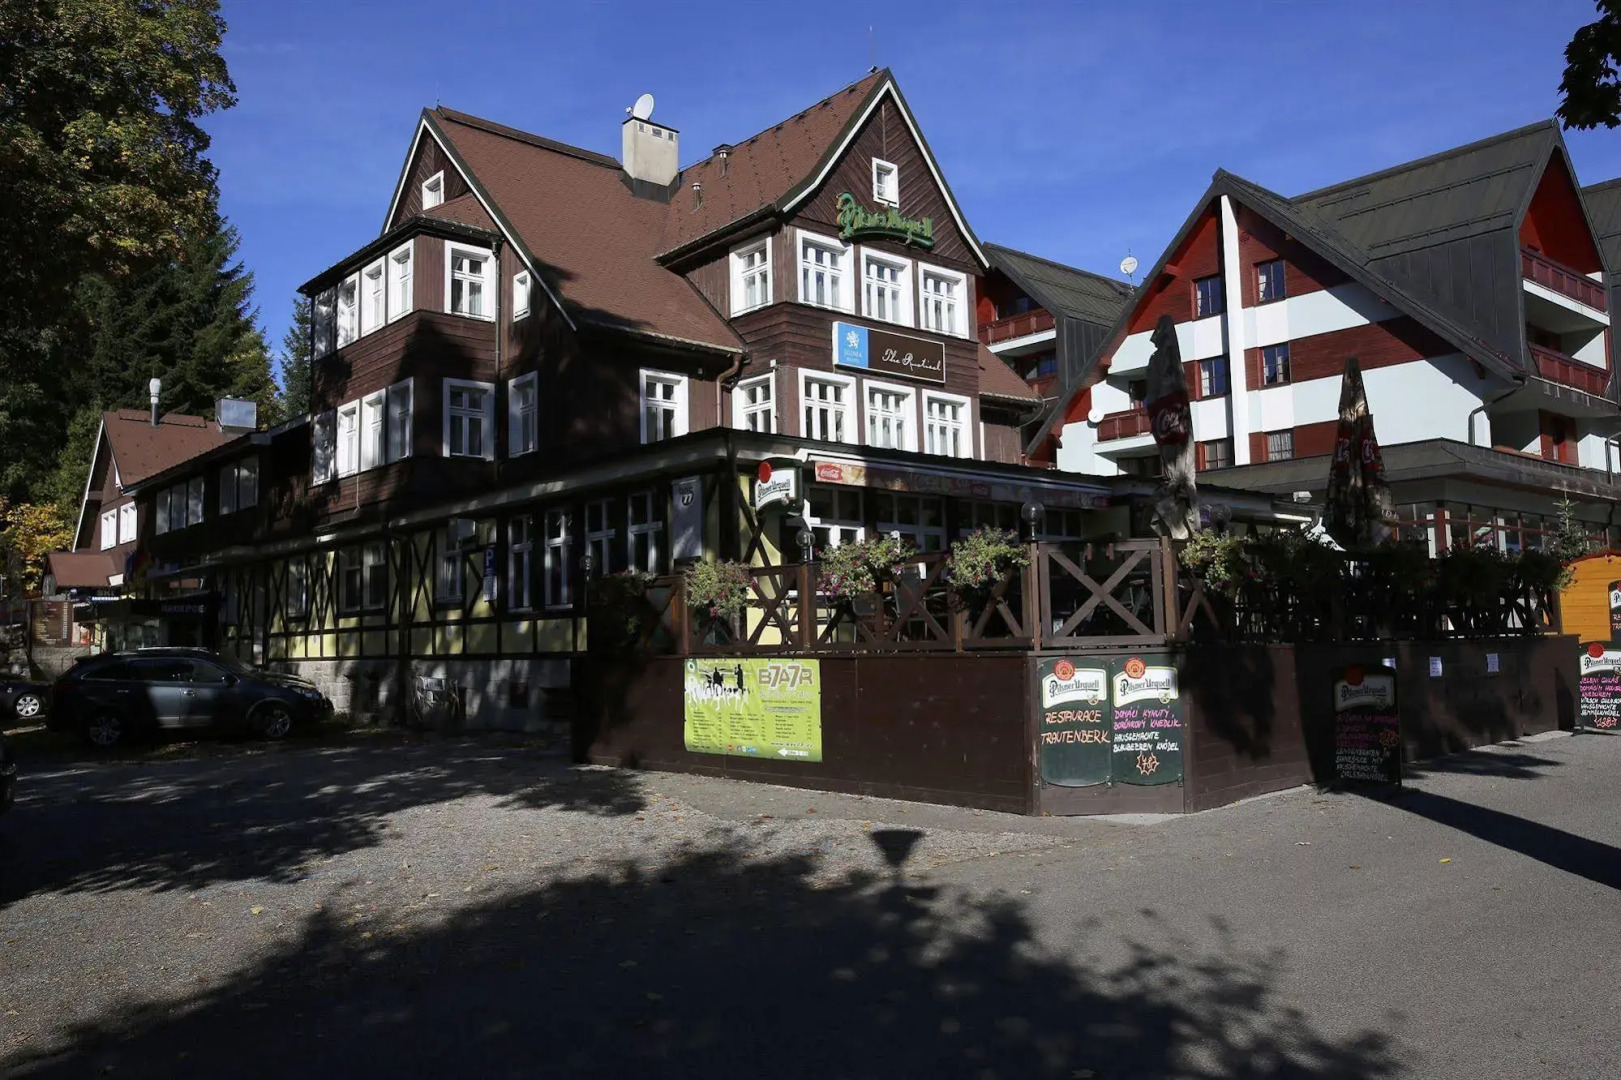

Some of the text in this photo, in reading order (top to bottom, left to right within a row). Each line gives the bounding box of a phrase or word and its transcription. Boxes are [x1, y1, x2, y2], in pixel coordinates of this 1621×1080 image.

[882, 348, 900, 363] The
[485, 548, 494, 567] P
[1049, 679, 1099, 697] Pilsner Urquell
[1120, 678, 1171, 697] Pilsner Urquell
[1045, 710, 1102, 725] RESTAURACE
[1041, 729, 1111, 745] TRAUTENBERK
